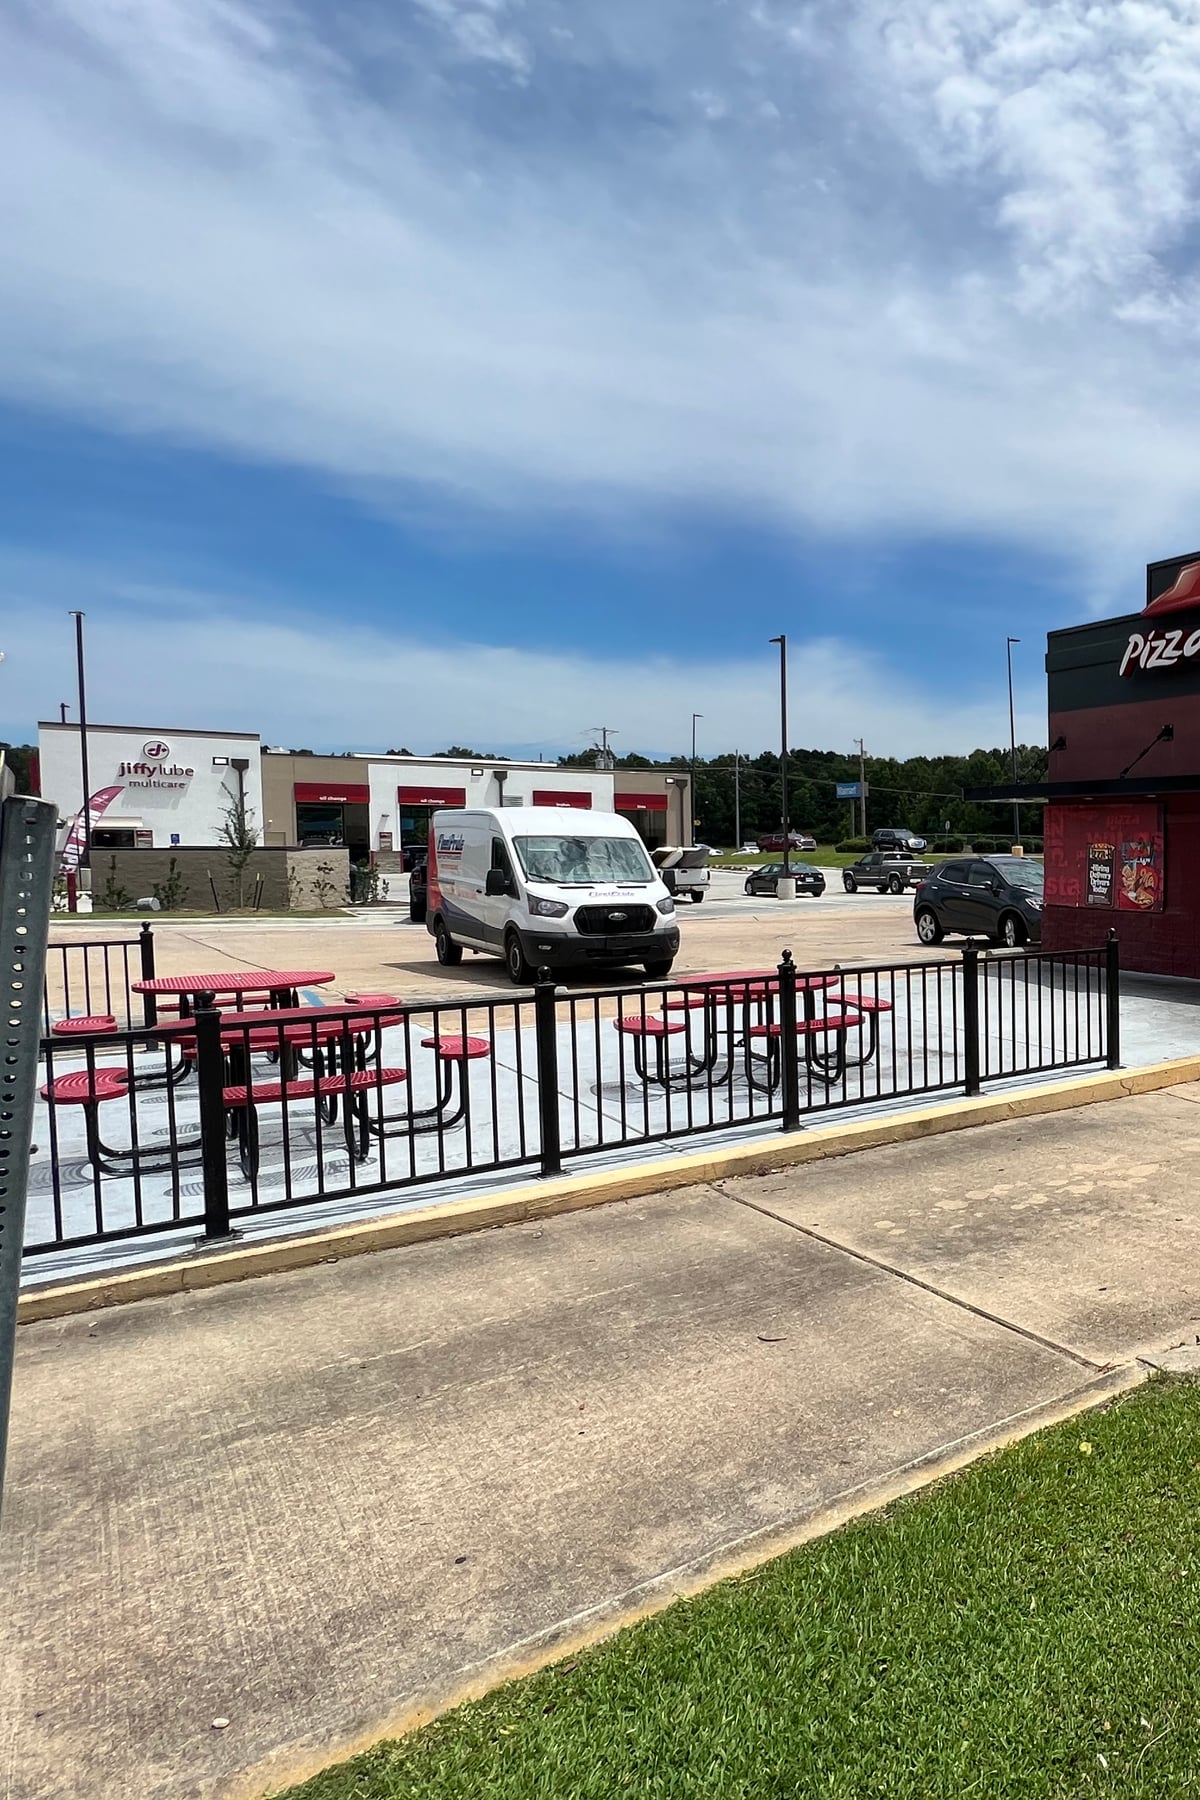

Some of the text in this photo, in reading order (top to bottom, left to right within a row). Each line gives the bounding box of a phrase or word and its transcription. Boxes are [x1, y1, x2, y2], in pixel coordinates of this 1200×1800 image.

[119, 762, 194, 778] jiffy lube
[129, 779, 186, 789] multicare
